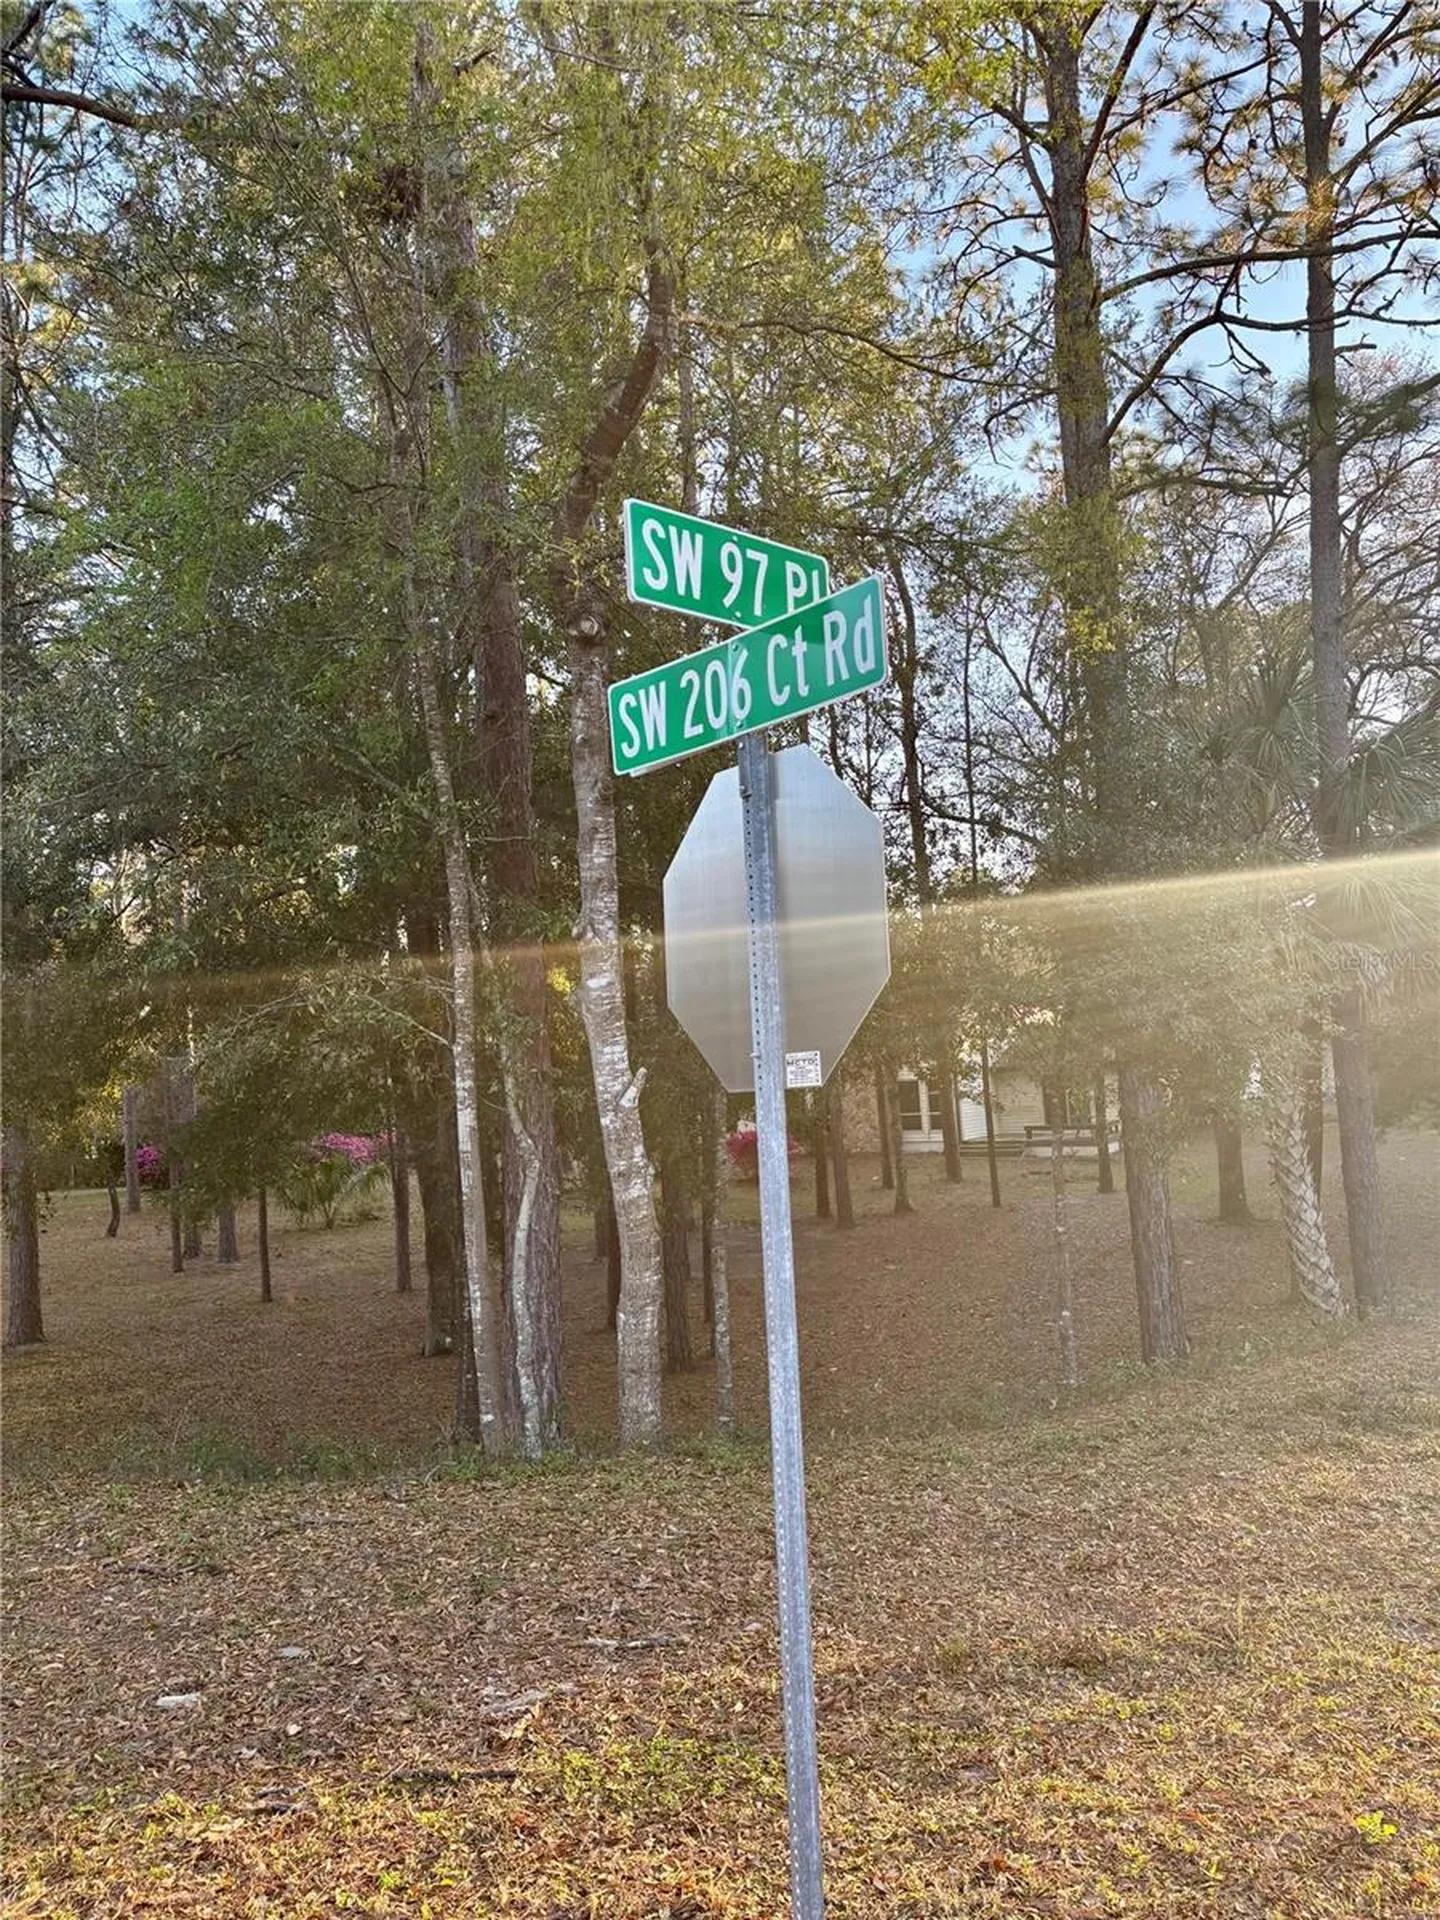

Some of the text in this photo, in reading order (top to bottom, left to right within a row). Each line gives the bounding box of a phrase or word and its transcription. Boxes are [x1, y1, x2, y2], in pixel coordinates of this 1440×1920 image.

[641, 518, 703, 600] SW
[720, 541, 768, 617] 97
[618, 594, 875, 758] SW 206 Ct Rd
